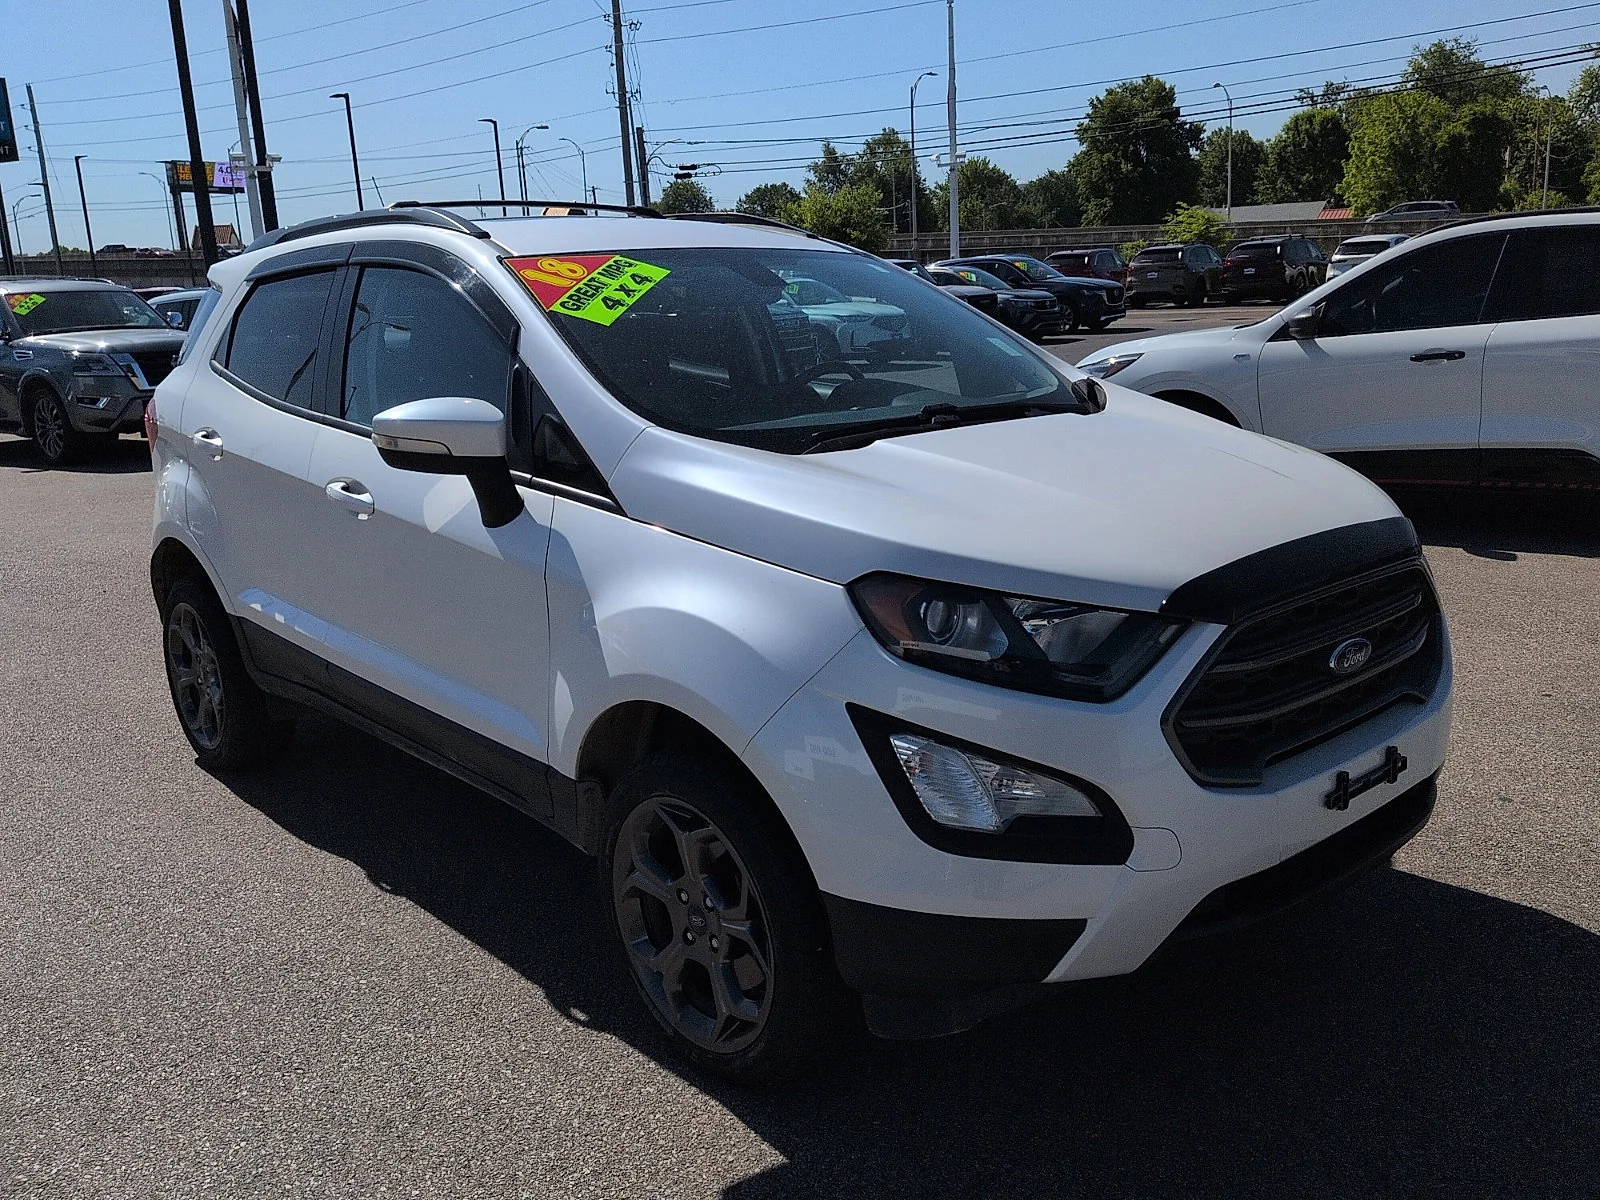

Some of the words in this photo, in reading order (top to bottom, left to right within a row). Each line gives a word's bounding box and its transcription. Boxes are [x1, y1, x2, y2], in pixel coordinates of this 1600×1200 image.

[519, 257, 588, 288] 18
[559, 276, 612, 312] GREAT
[599, 258, 638, 281] MPG
[600, 295, 630, 312] 4
[629, 272, 657, 288] 4
